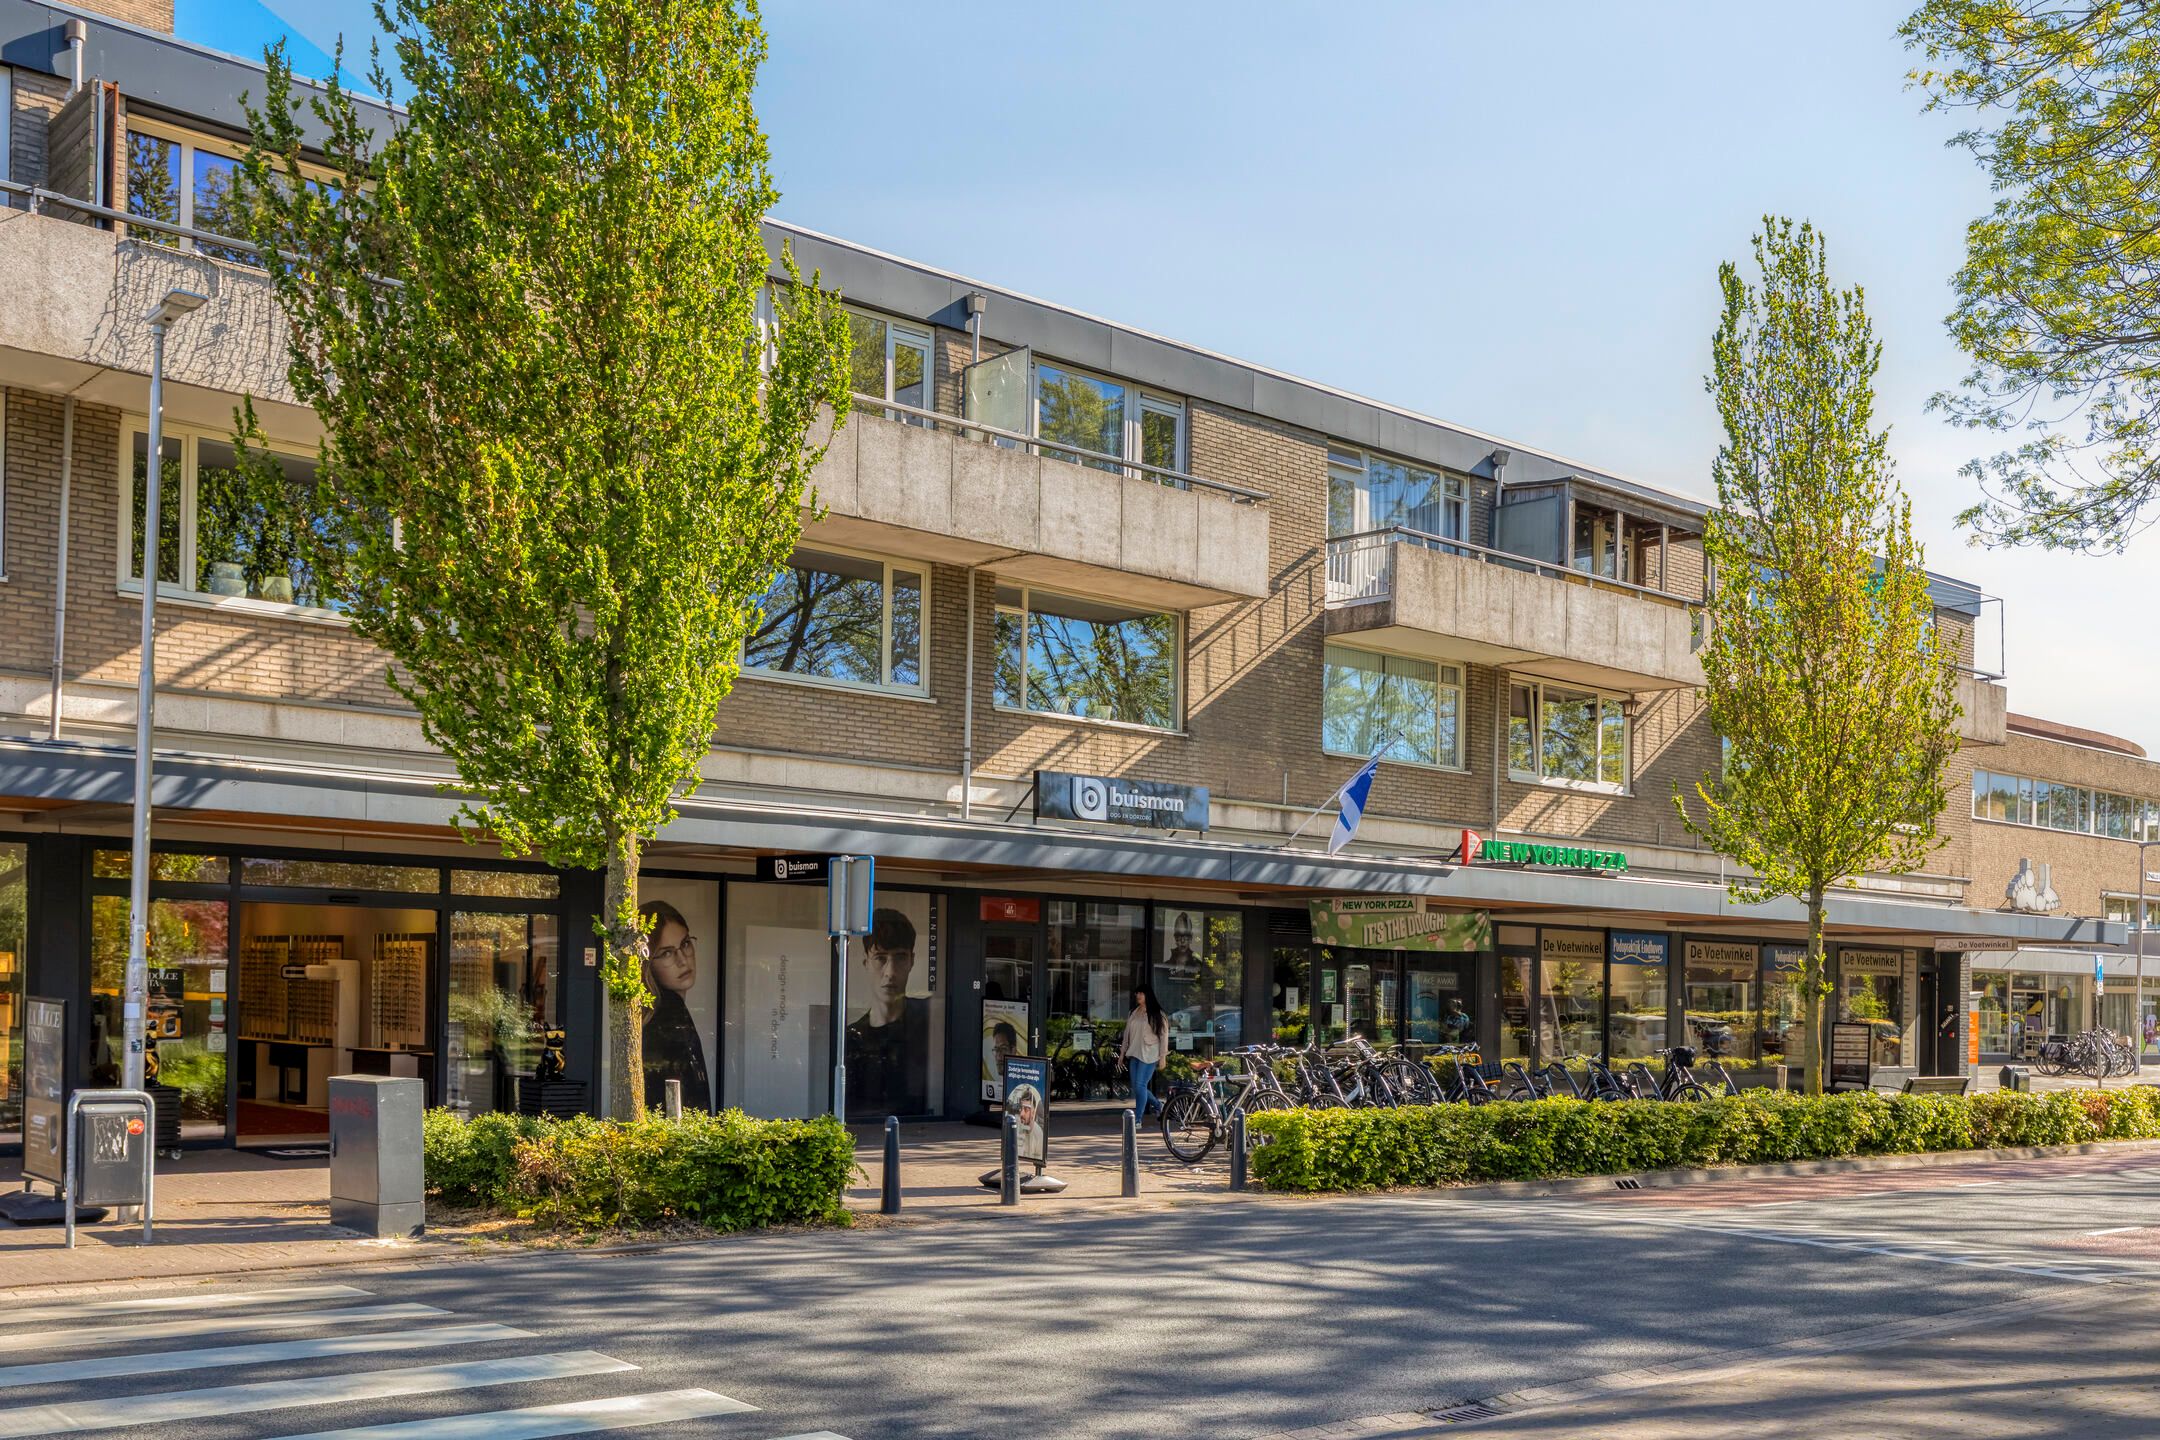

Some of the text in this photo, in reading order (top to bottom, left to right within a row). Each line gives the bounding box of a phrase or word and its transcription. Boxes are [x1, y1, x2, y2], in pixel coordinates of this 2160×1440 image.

[1109, 786, 1184, 812] buisman
[1482, 839, 1529, 863] NEW
[1529, 843, 1578, 867] YORK
[1578, 848, 1628, 872] PIZZA
[788, 861, 818, 871] buisman
[1342, 900, 1414, 910] NEW YORK PIZZA
[1363, 912, 1447, 946] IT'S THE DOUGH!
[1543, 940, 1603, 954] De Voetwinkel
[1969, 941, 2009, 949] Voetwinkel
[1690, 945, 1753, 961] De Voetwinkel
[1844, 952, 1897, 967] De Voetwinkel
[973, 980, 981, 989] 68
[1437, 975, 1456, 985] AWAY
